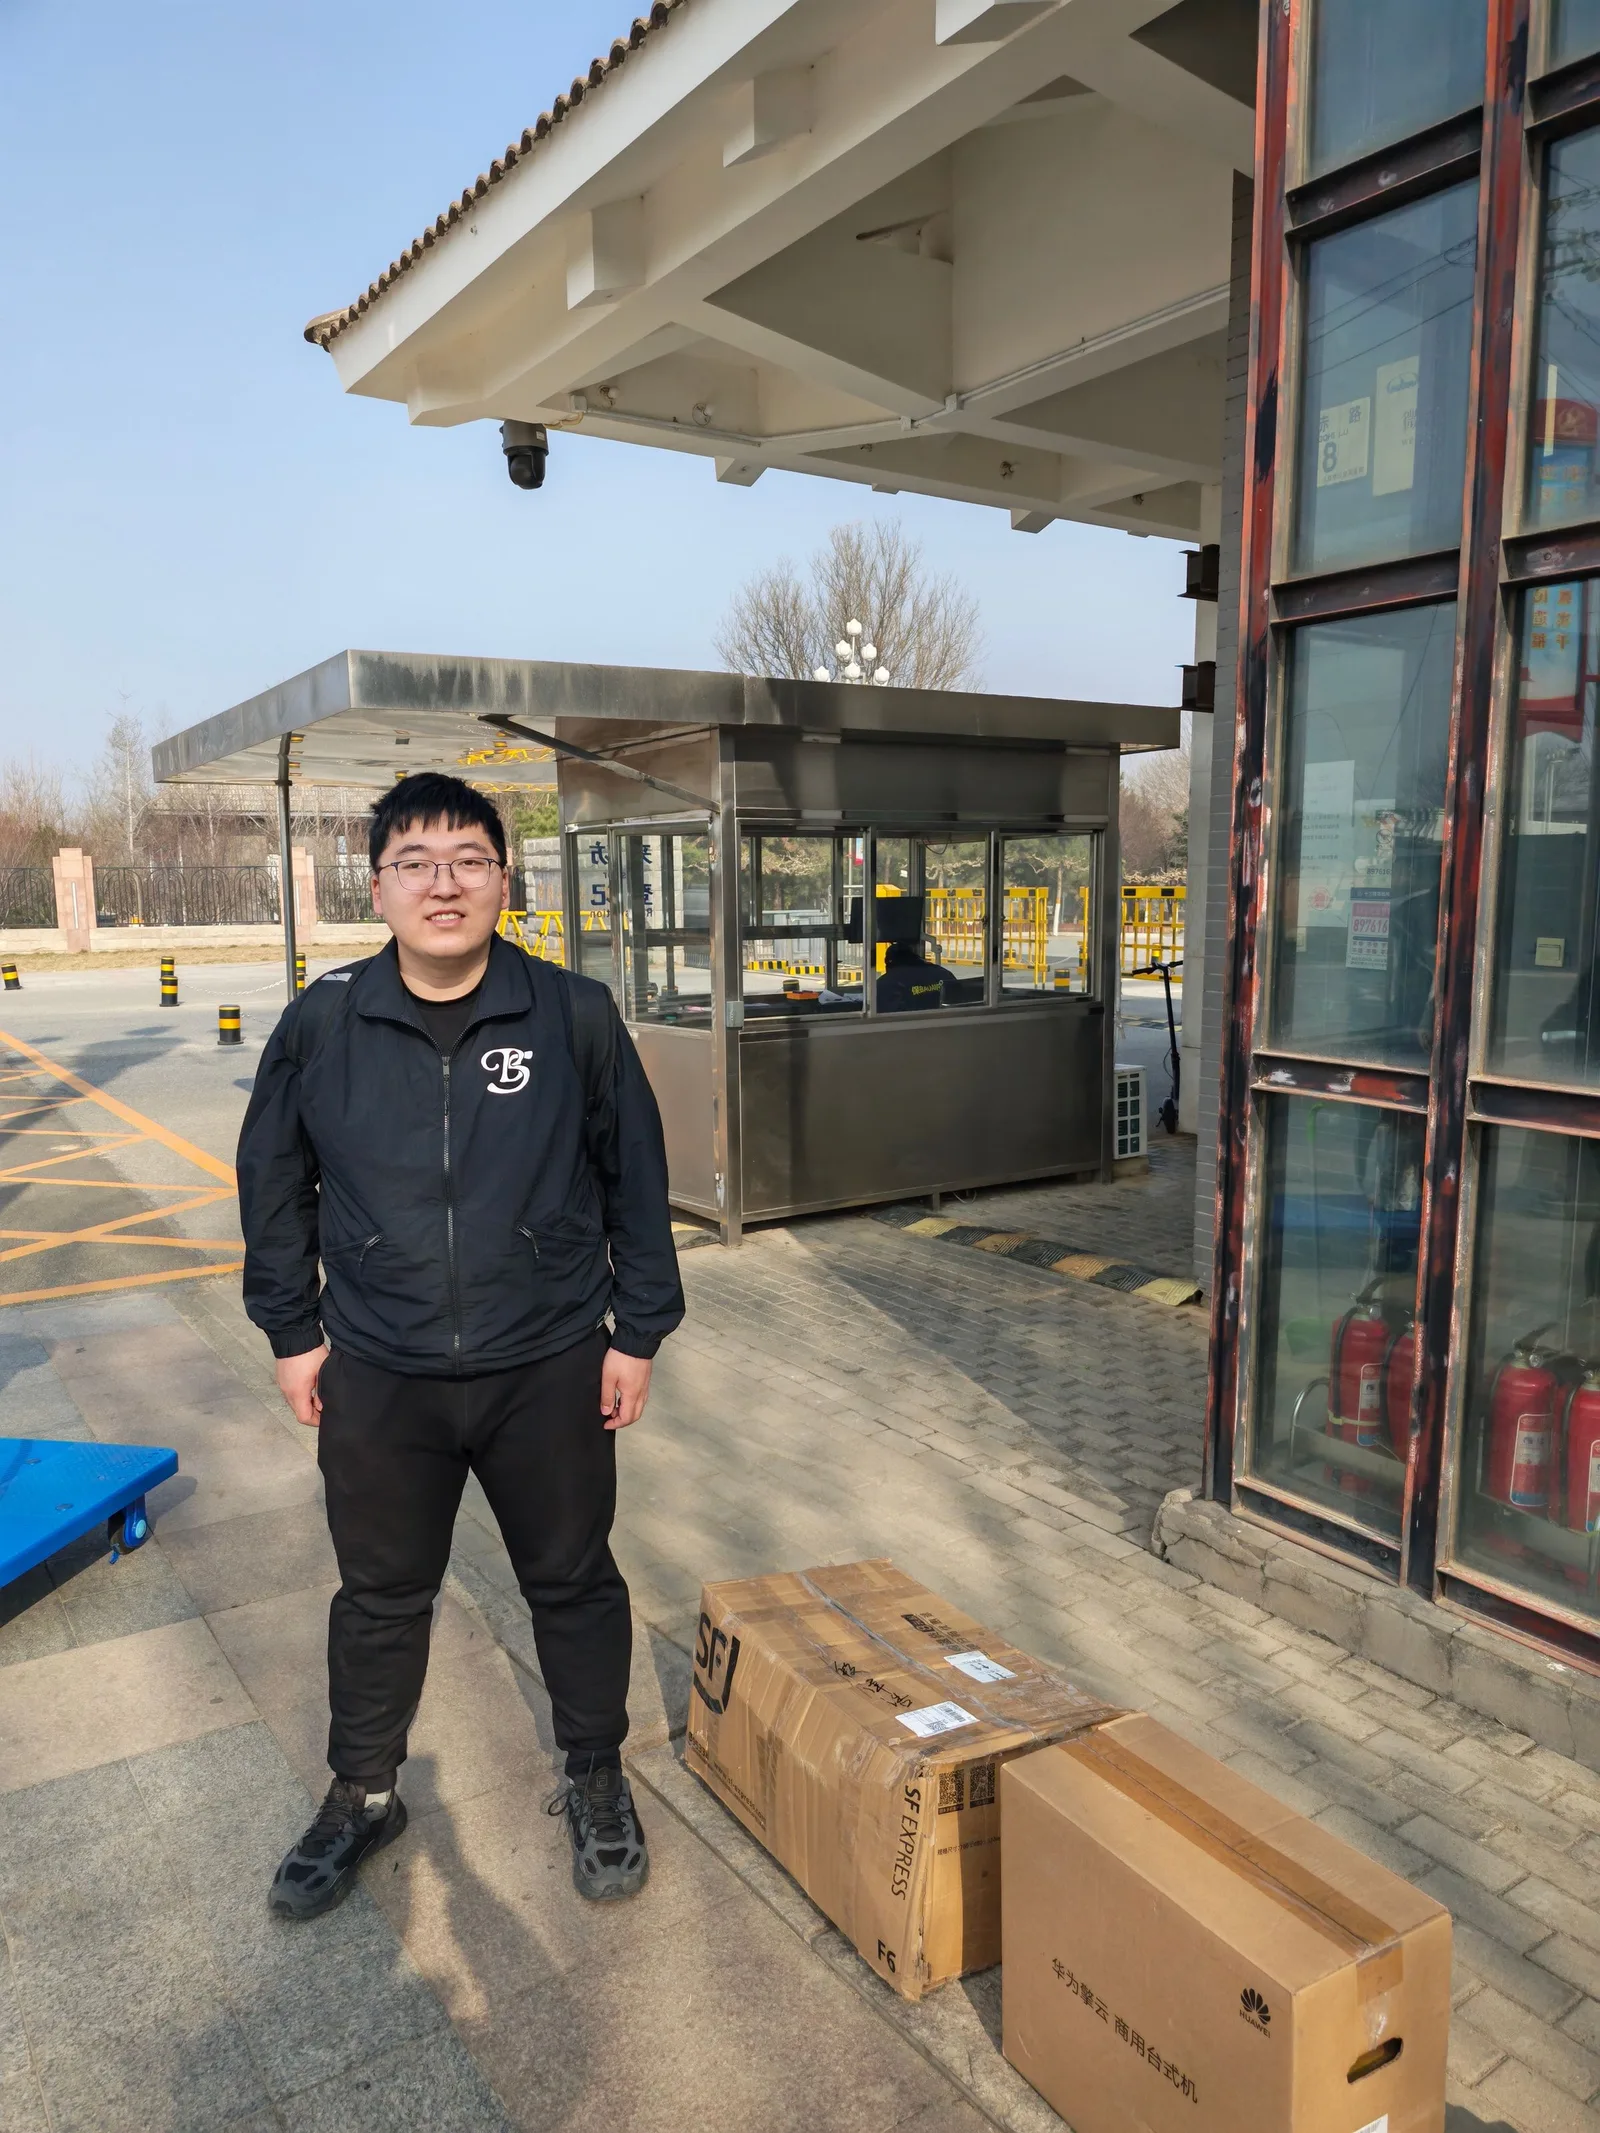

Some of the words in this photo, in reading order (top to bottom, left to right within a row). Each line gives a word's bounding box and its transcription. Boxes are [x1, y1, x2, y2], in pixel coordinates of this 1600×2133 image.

[903, 1784, 922, 1815] SF
[891, 1815, 919, 1901] EXPRESS
[877, 1938, 896, 1974] F6
[1052, 1957, 1109, 2024] 华为擎云
[1114, 2014, 1198, 2104] 商用台式机
[1239, 2008, 1271, 2039] HUAWEI
